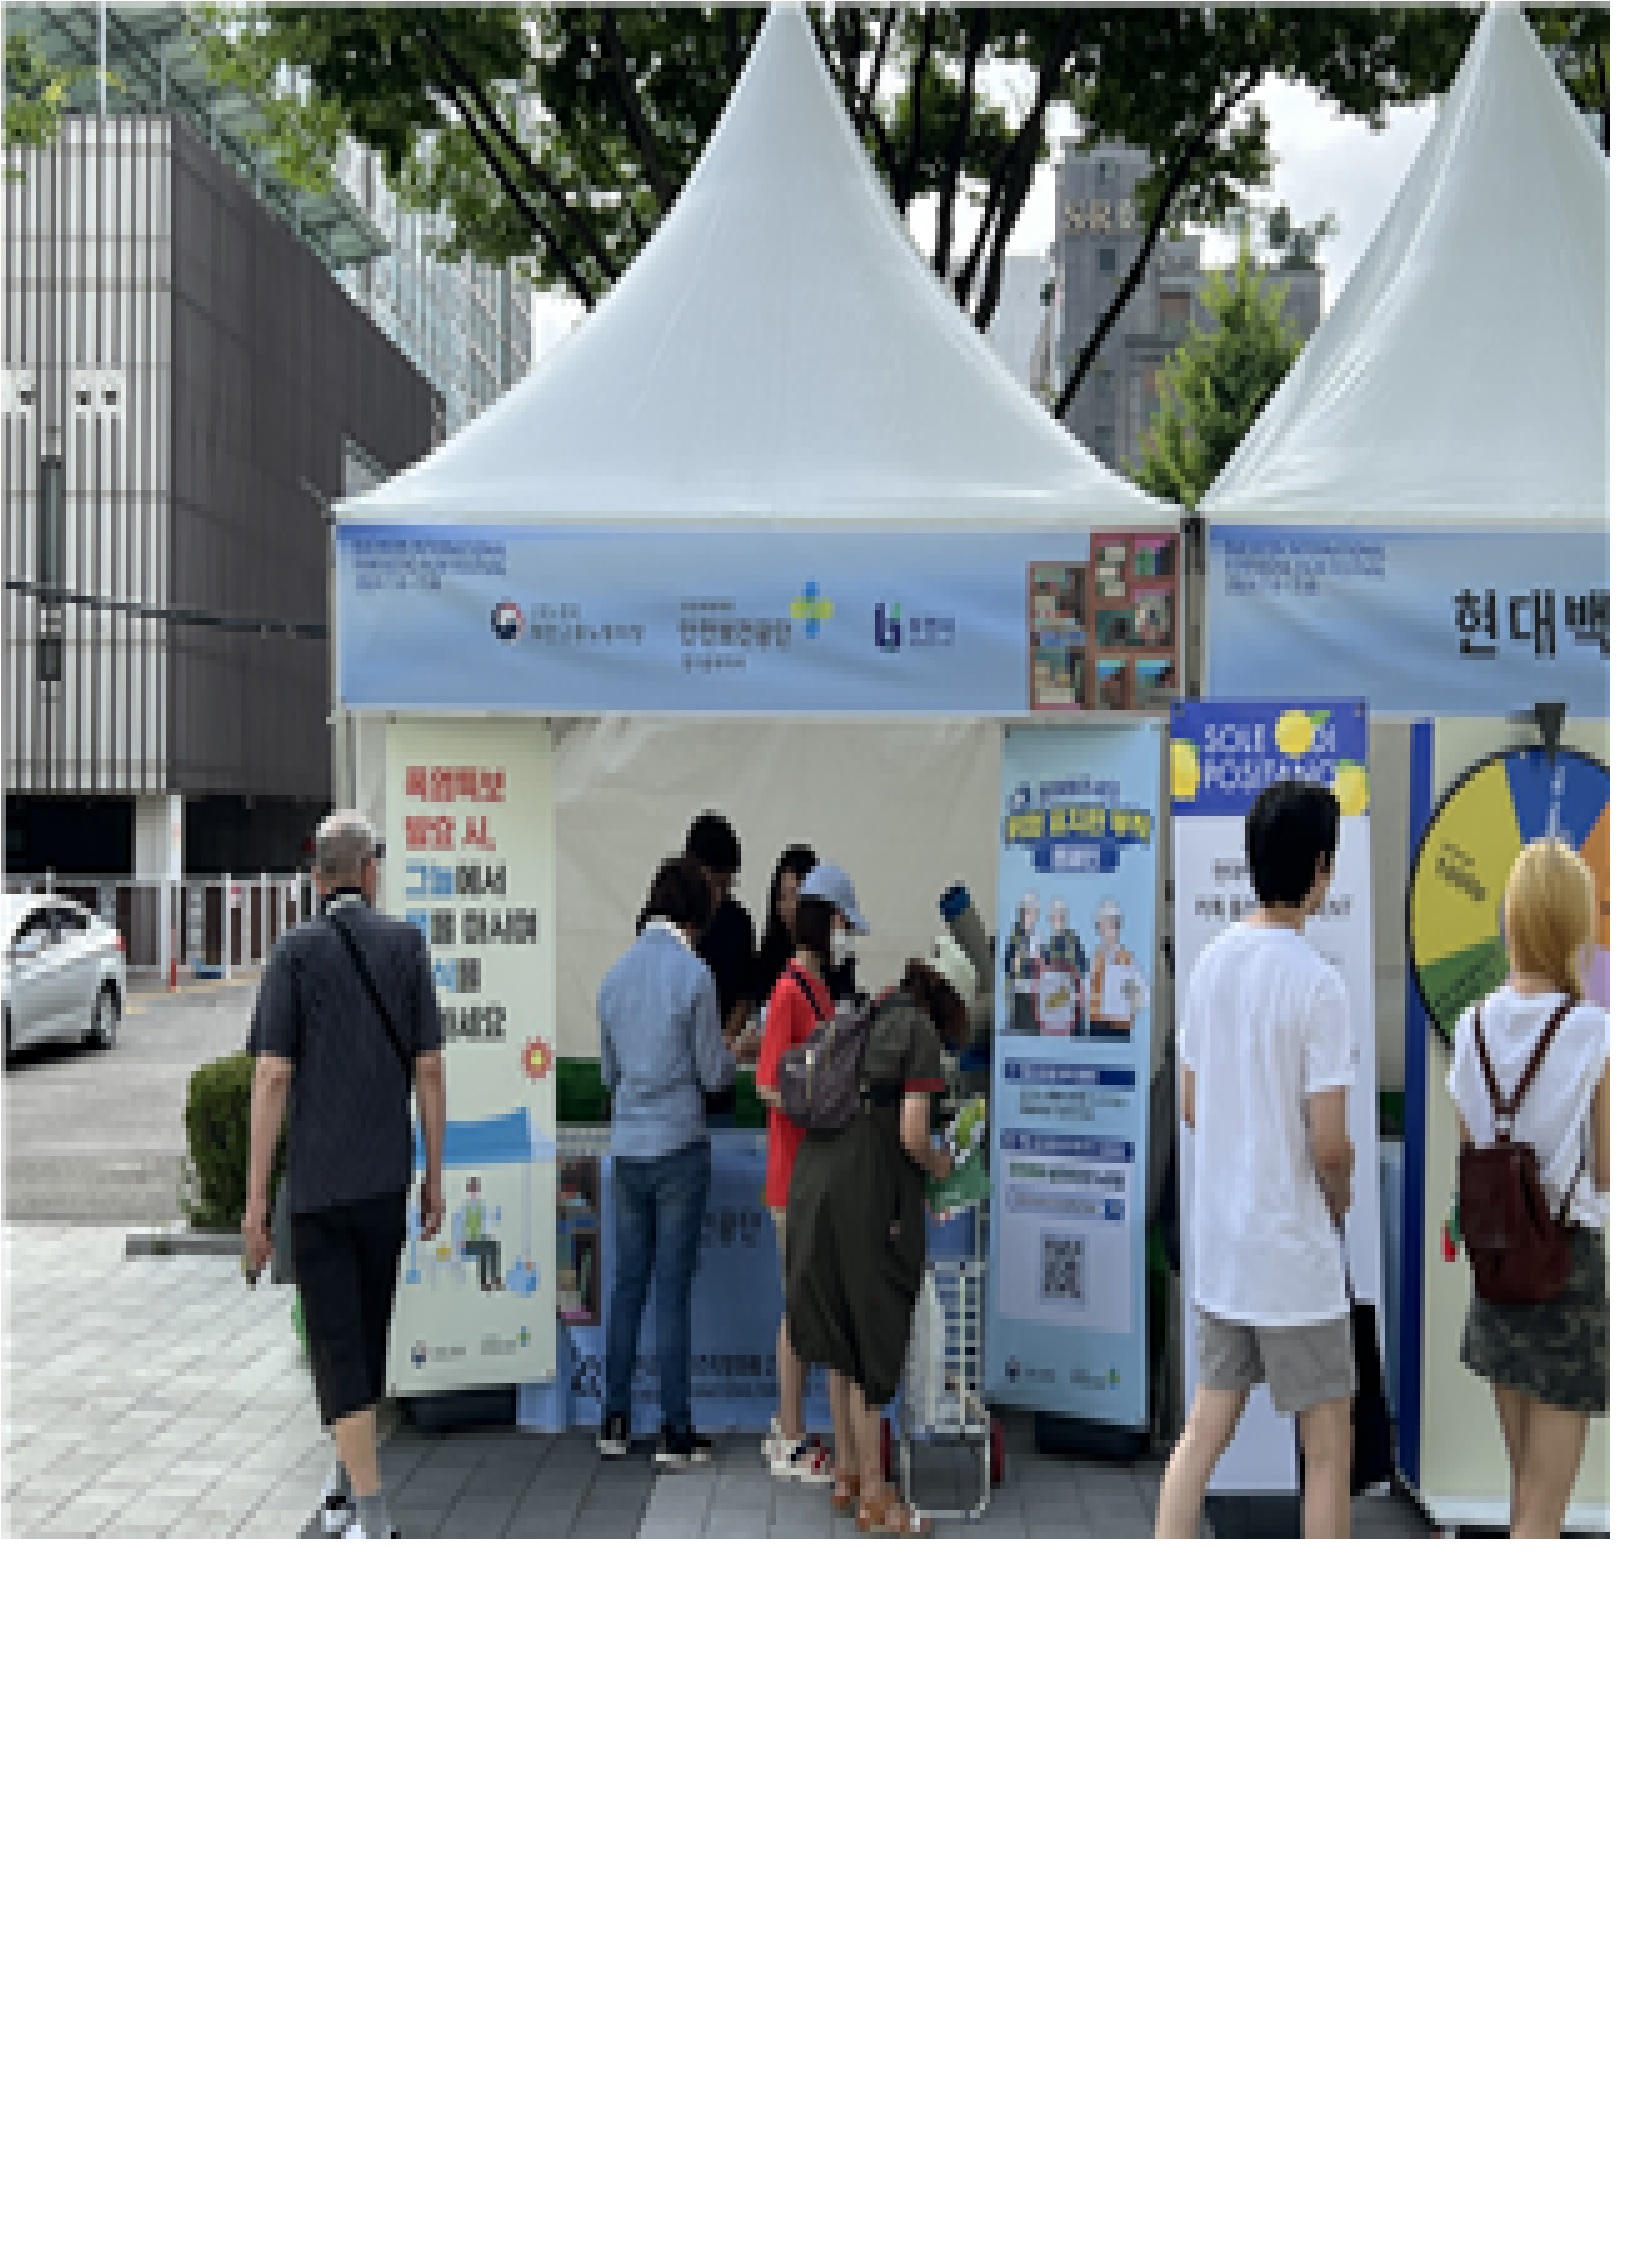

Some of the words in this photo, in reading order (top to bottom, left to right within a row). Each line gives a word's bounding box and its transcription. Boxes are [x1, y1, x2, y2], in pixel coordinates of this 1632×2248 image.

[1205, 723, 1266, 754] SOLE
[406, 765, 506, 804] 폭염특보
[1205, 758, 1337, 793] POSITANO
[405, 815, 455, 851] 발효
[405, 862, 508, 899] 그늘에서
[431, 957, 481, 994] 식을
